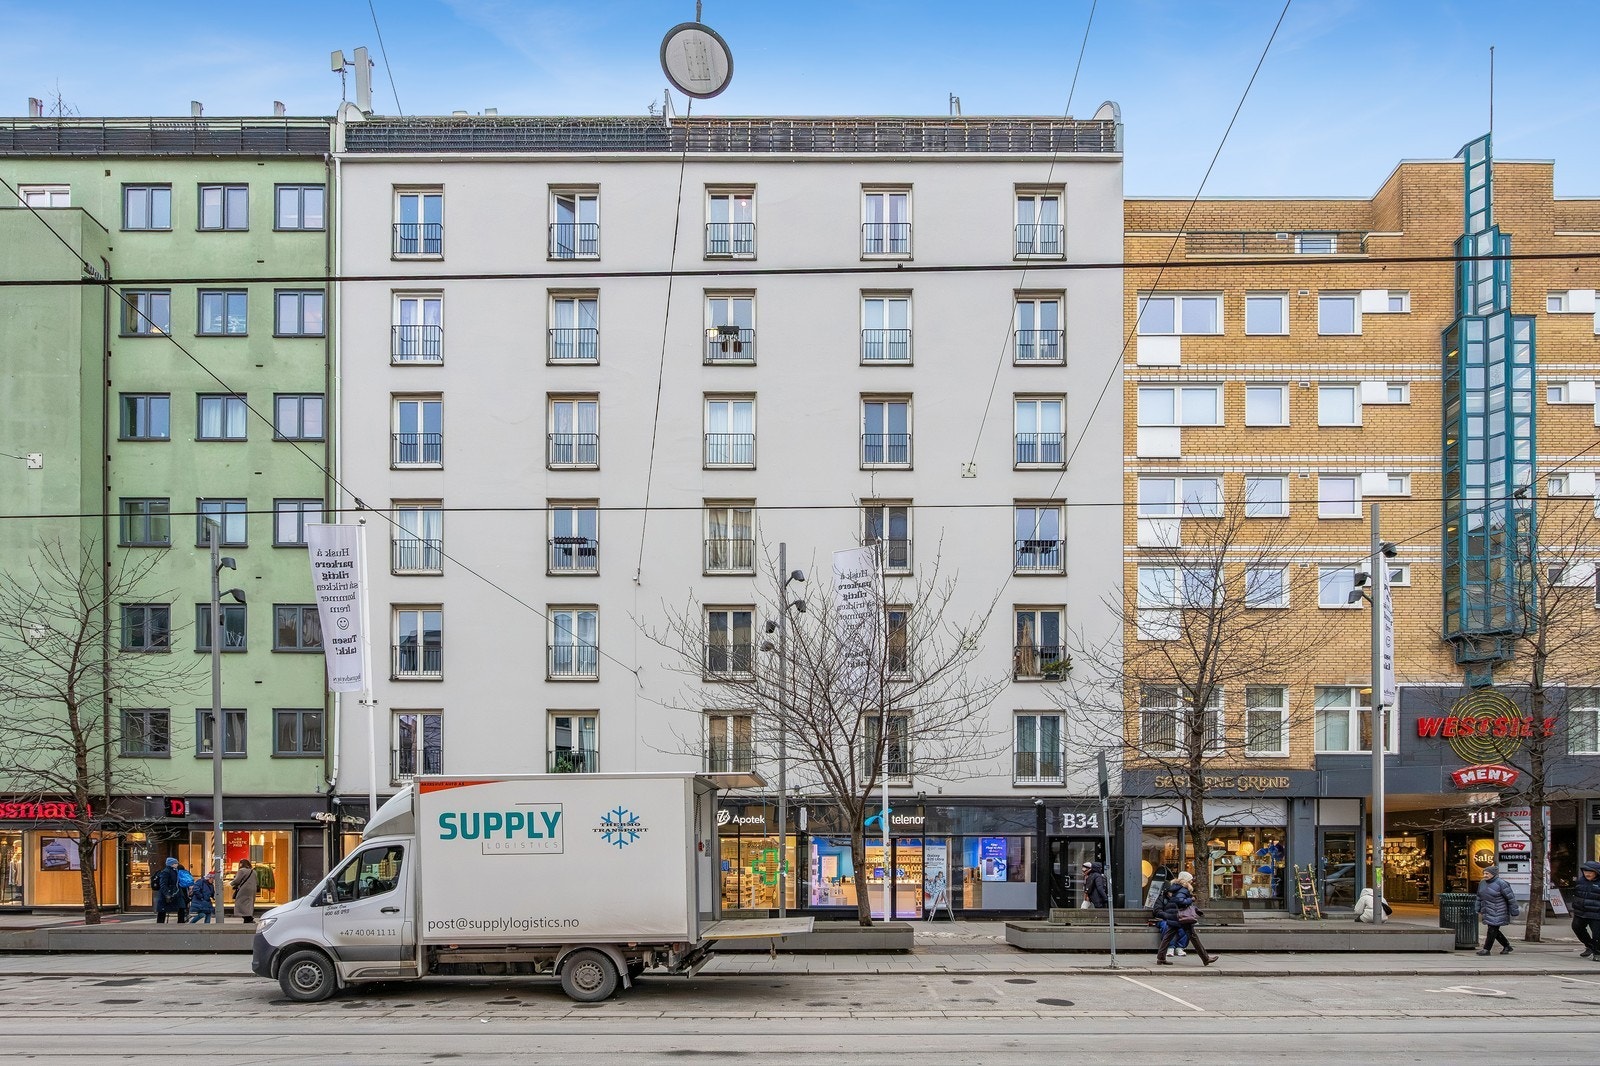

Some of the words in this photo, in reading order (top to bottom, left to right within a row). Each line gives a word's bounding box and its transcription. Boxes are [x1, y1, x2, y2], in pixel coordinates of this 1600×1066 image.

[1460, 769, 1514, 783] MENY
[1155, 775, 1235, 791] SØSTENE
[1237, 775, 1290, 791] GRENE
[732, 815, 765, 825] Apotek
[891, 814, 925, 824] telenor
[1062, 813, 1098, 829] B34
[439, 811, 561, 840] SUPPLY
[487, 841, 559, 850] LOGISTICS
[1474, 854, 1495, 864] Salg
[428, 917, 580, 931] post@supplylogistics.no
[388, 928, 396, 936] 11
